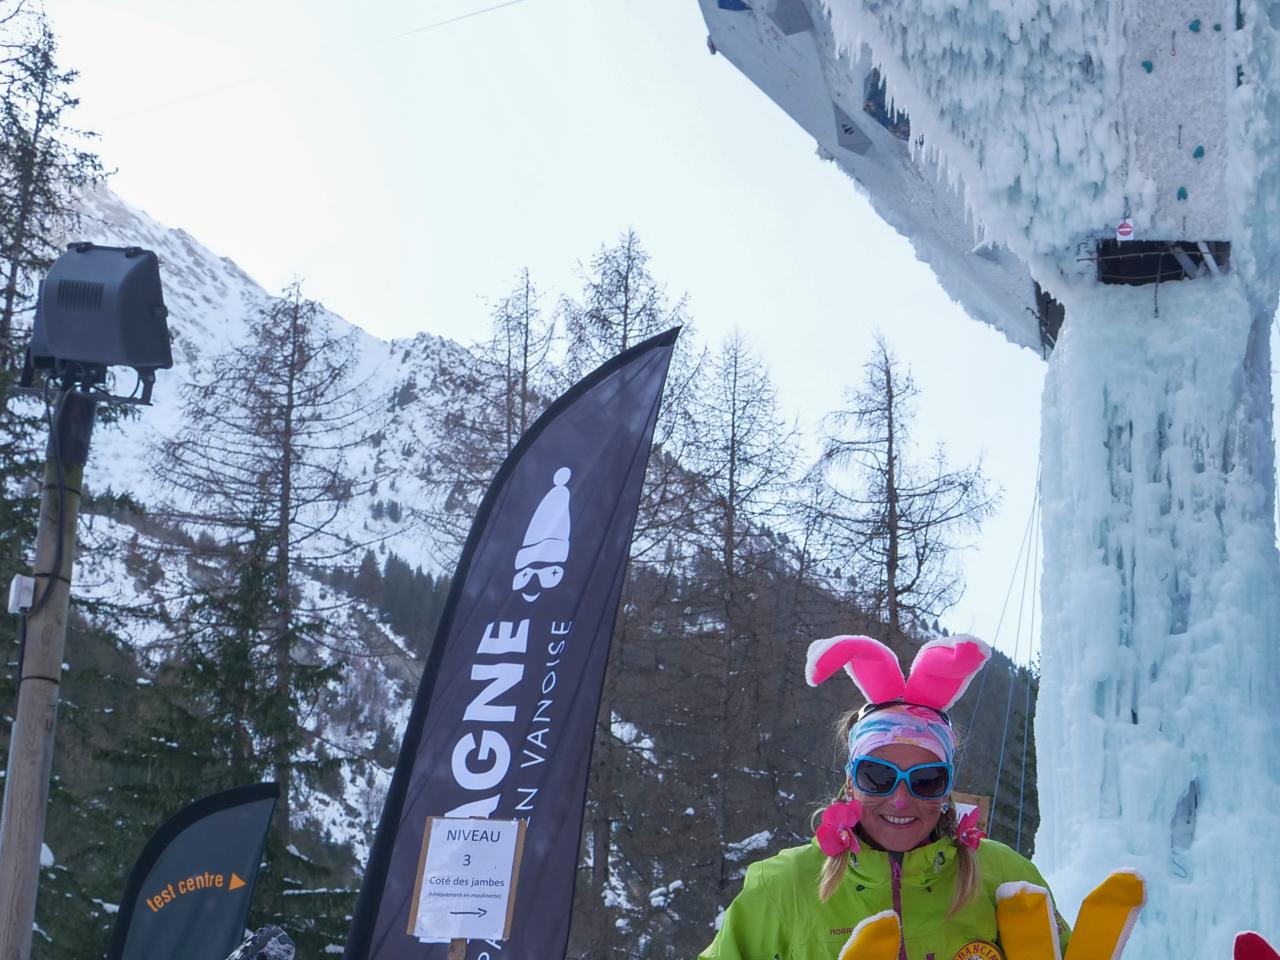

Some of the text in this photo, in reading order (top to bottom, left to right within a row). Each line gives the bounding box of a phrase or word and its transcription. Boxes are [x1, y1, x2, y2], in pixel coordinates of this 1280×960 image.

[521, 620, 572, 768] VANOISE
[446, 829, 501, 843] NIVEAU
[462, 854, 471, 867] 3
[429, 876, 505, 888] Coté des jambes
[146, 871, 224, 912] test centre
